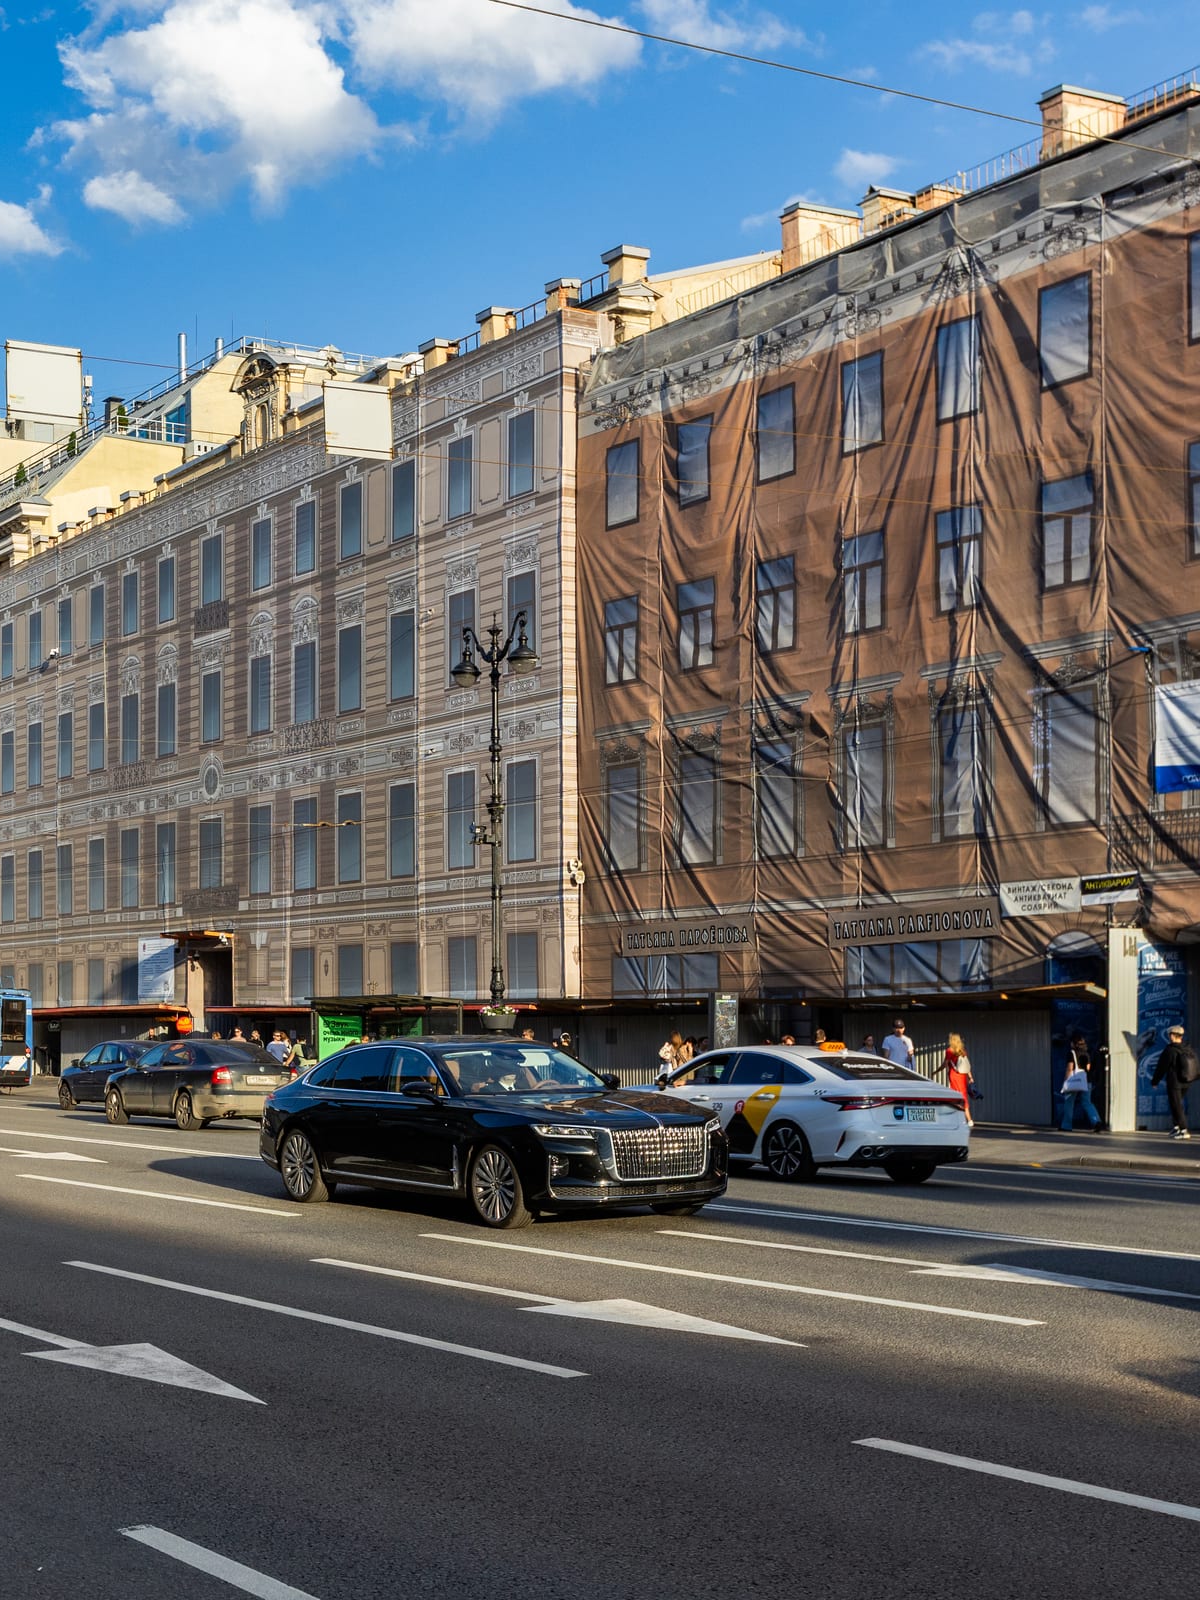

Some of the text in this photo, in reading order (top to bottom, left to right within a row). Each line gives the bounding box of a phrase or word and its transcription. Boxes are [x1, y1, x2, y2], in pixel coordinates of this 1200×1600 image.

[1007, 882, 1074, 894] ВИНТАЖ/СЕКОНД
[1085, 877, 1135, 890] АНТИКВАРИАТ
[1013, 892, 1067, 903] АНТИКВАРИАТ
[1021, 902, 1059, 912] СОЛЯРИЙ
[834, 908, 993, 939] TATYANA PARFIONOVA
[627, 925, 749, 949] ТАТЬЯНА ПАРФЁНОВА
